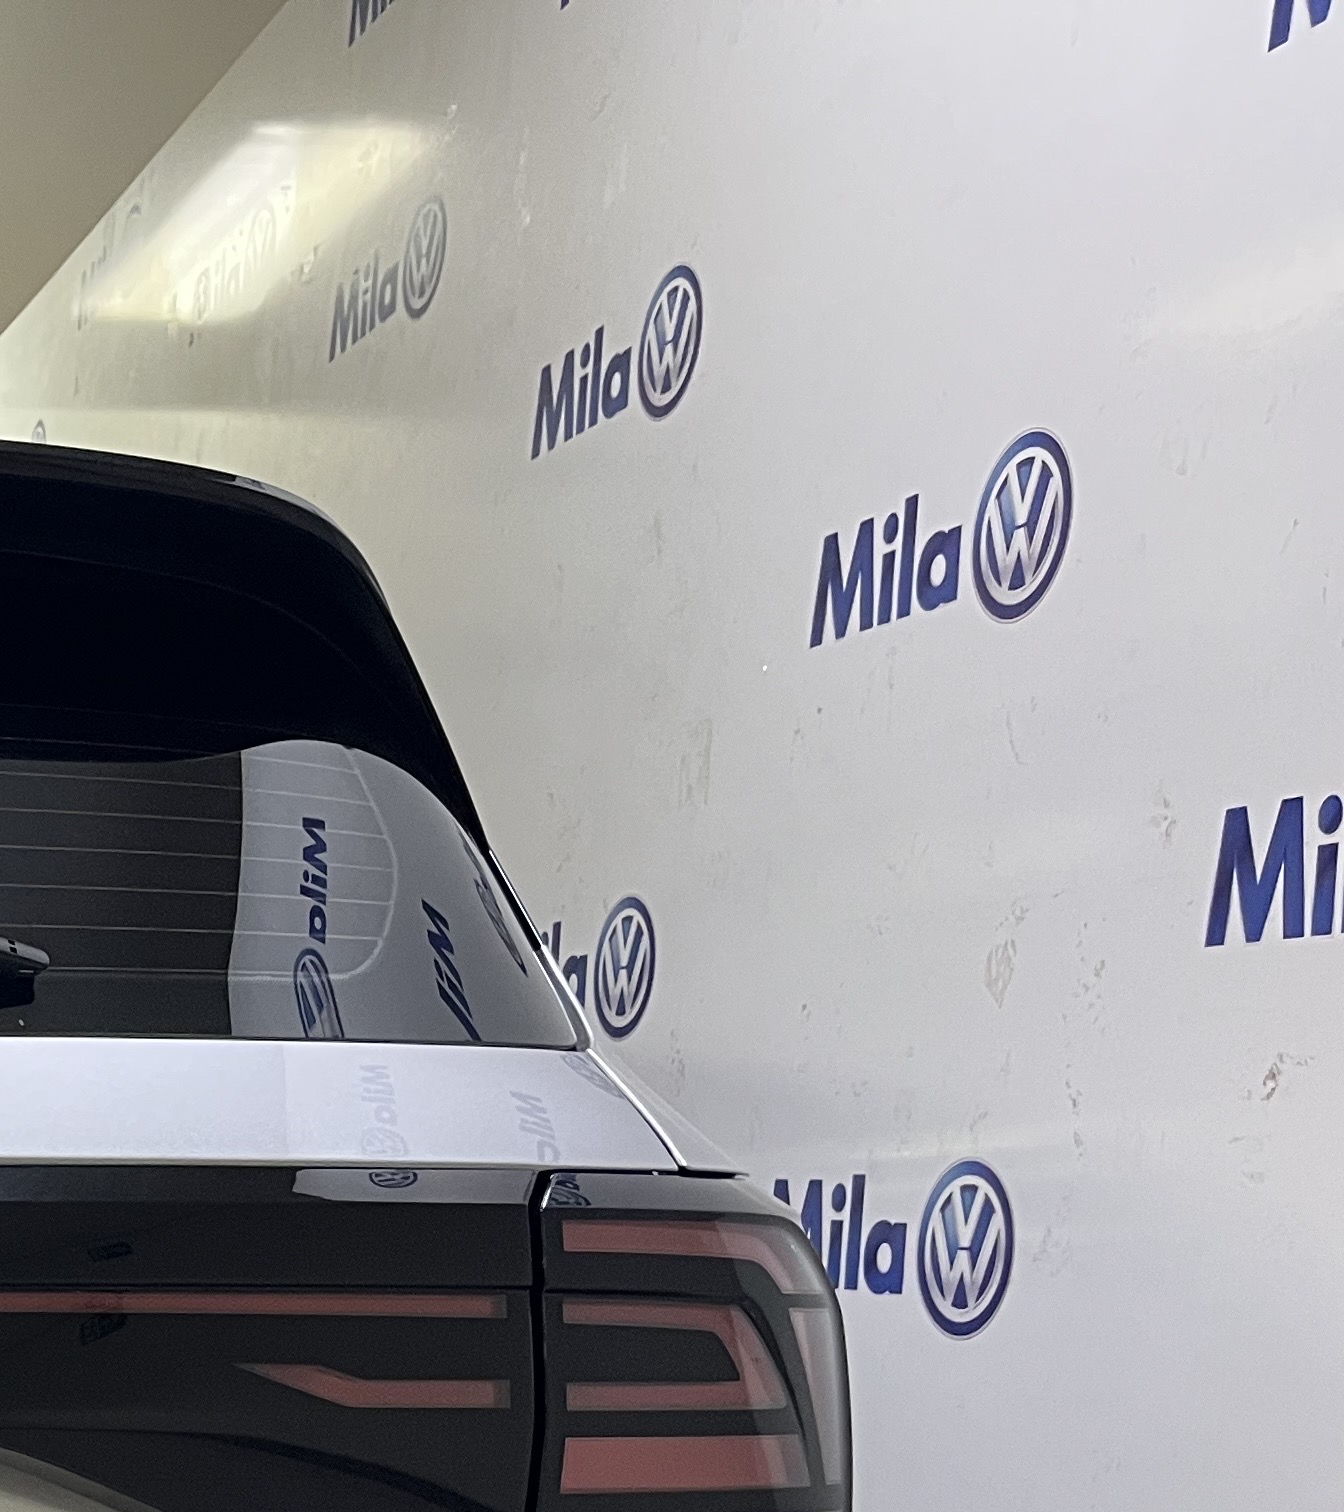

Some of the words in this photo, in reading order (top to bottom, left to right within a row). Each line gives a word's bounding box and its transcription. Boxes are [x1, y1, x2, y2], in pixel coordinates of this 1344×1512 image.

[329, 249, 400, 364] Mila
[530, 324, 633, 461] Mila
[809, 493, 964, 649] Mila
[1204, 795, 1344, 947] Mi
